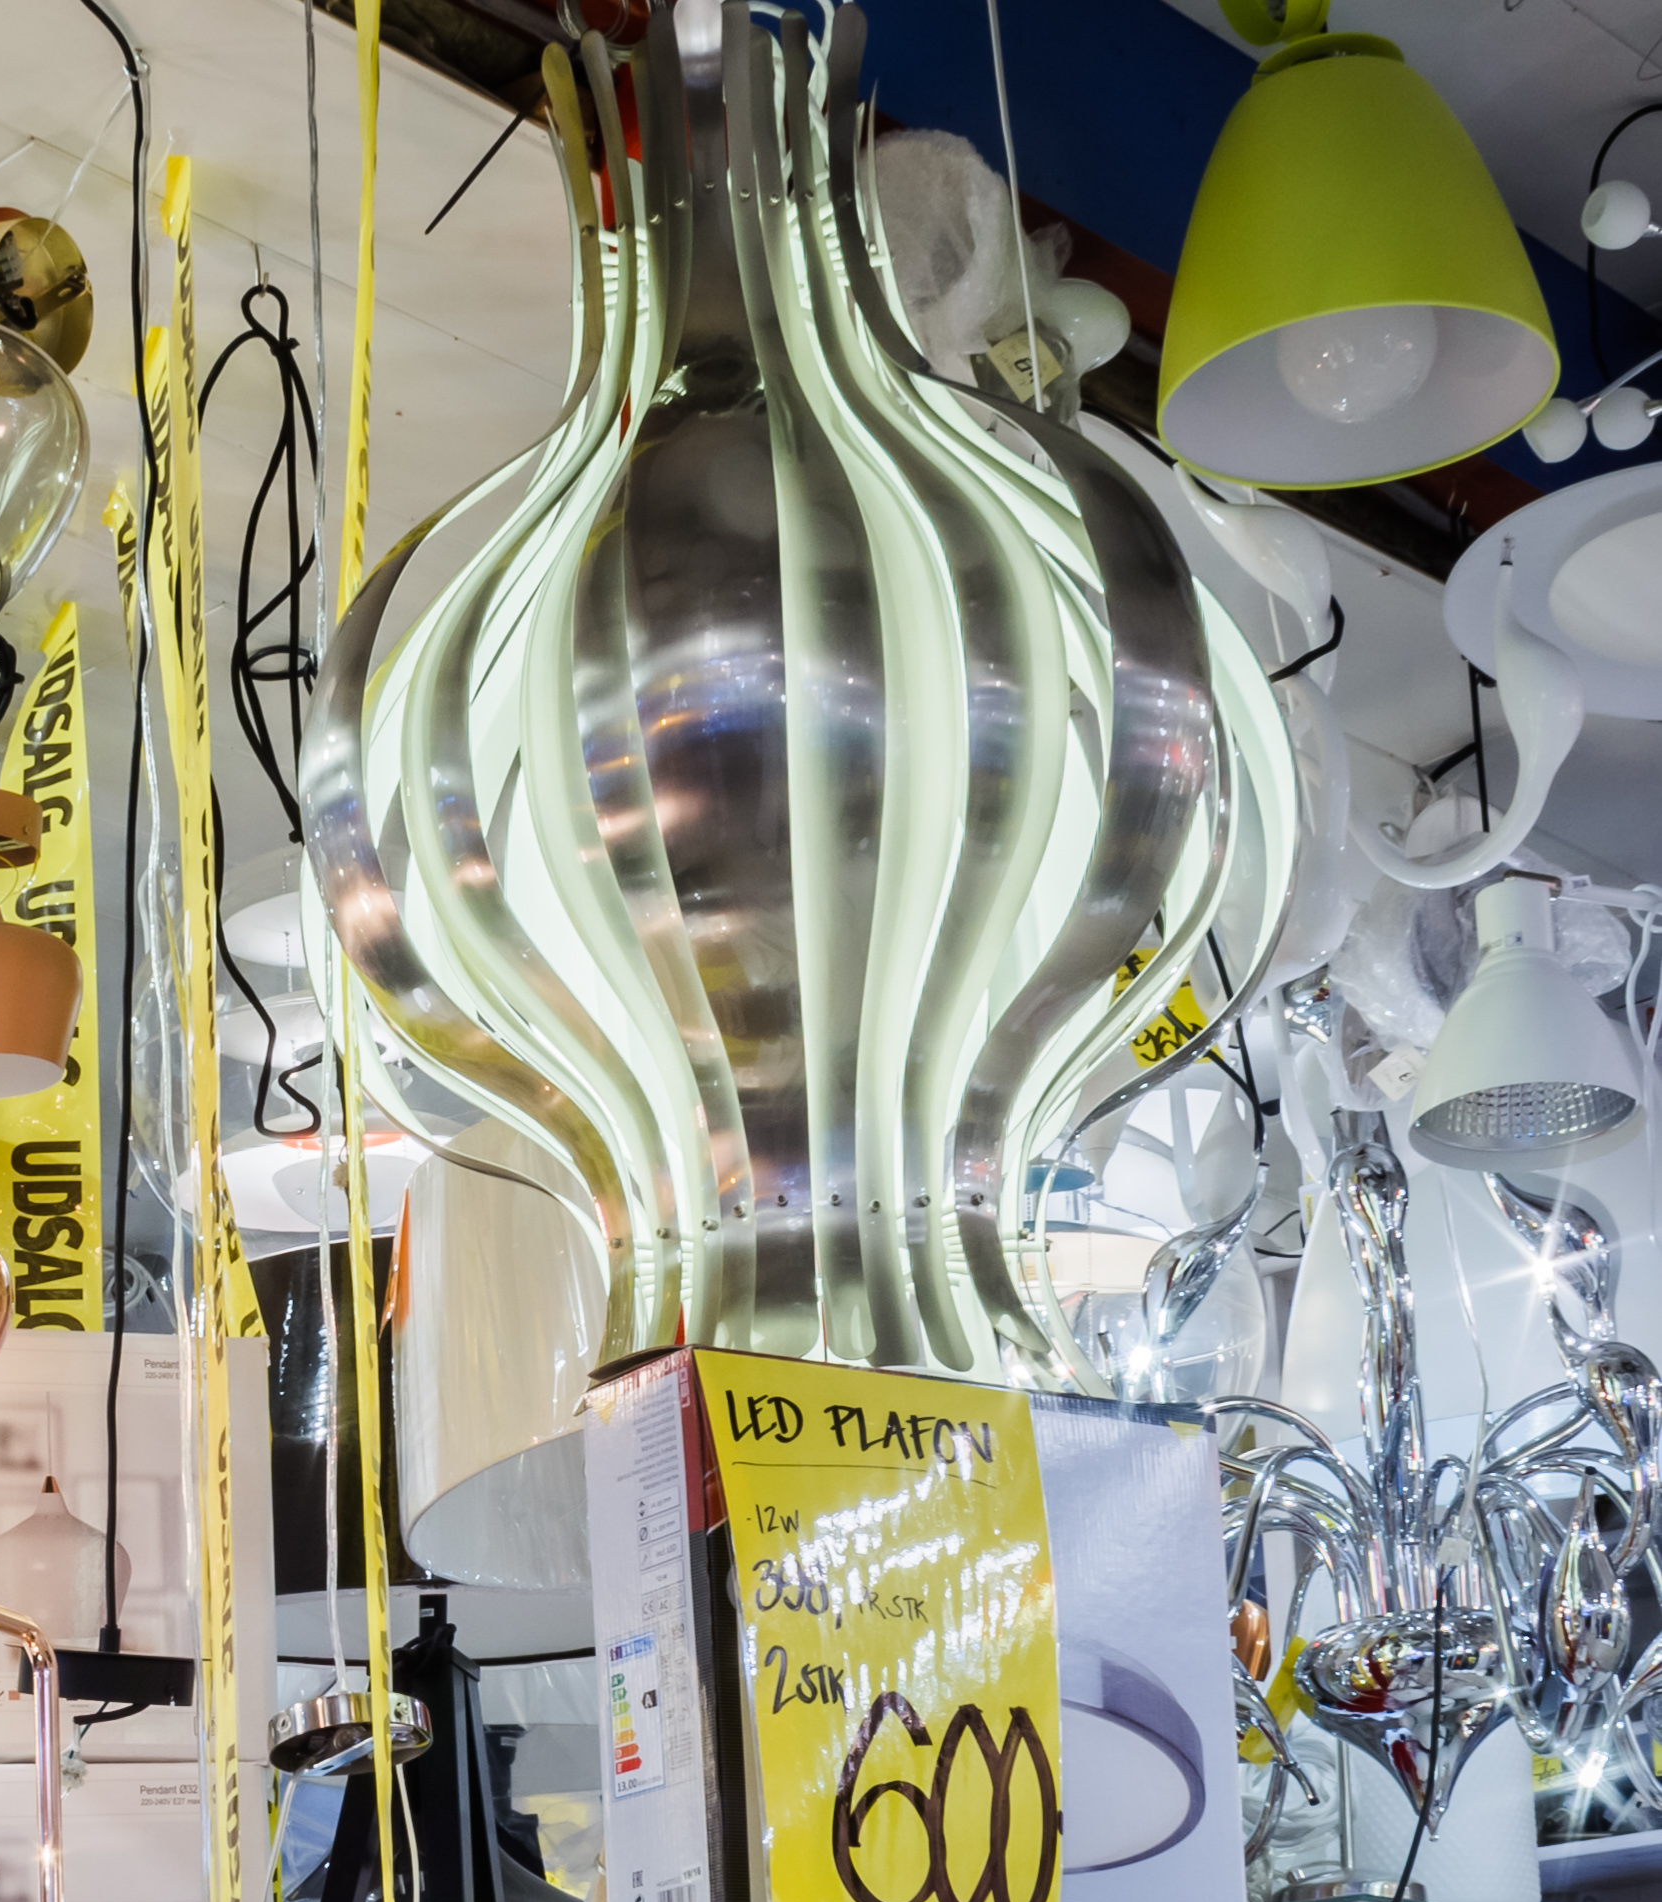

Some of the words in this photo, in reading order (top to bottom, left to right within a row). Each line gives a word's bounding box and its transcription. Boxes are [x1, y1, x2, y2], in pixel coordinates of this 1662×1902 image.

[23, 628, 76, 834] UDSALG
[725, 1389, 804, 1444] LED
[824, 1404, 995, 1466] PLAFON
[140, 1785, 178, 1796] Pendant
